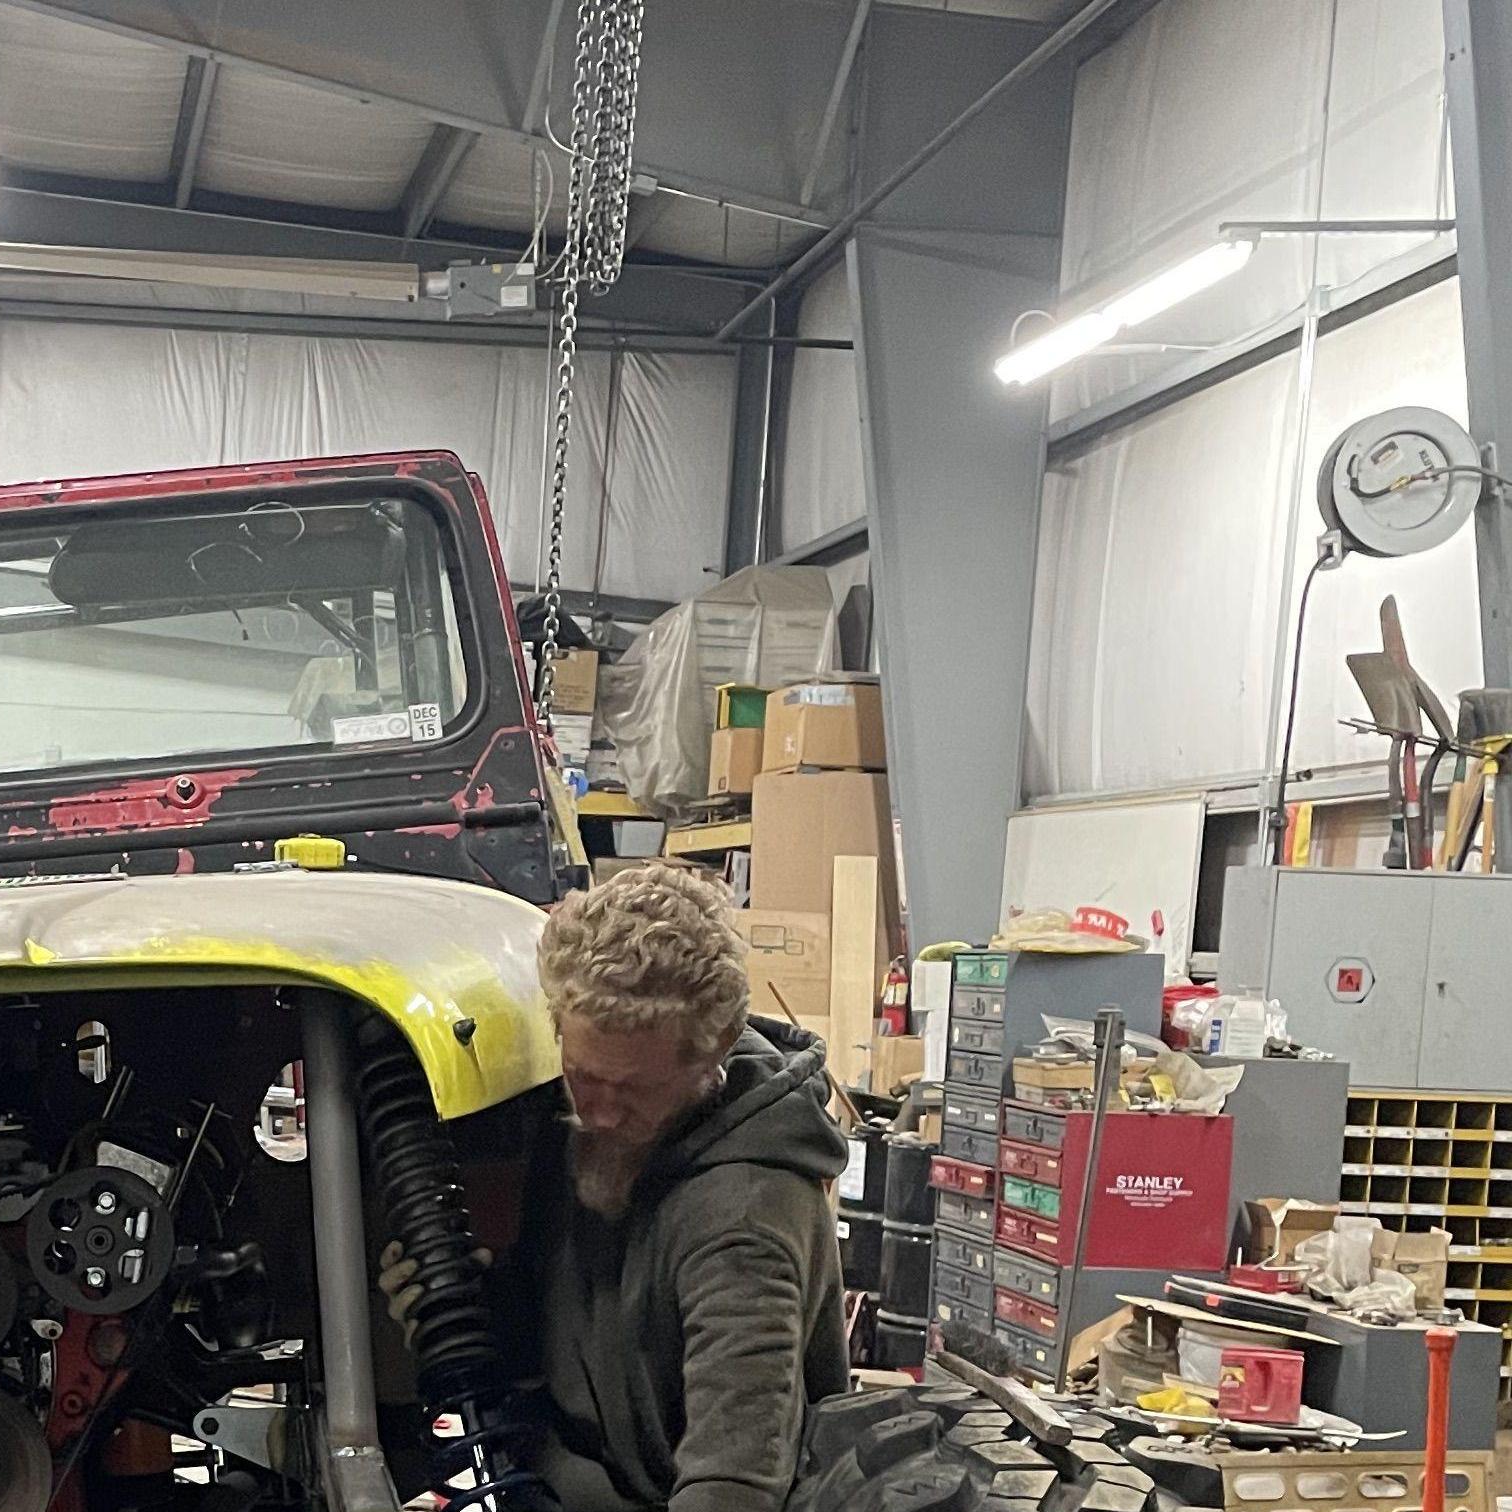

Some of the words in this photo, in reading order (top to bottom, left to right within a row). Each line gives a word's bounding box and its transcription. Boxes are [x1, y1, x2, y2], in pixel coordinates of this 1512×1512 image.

[413, 706, 438, 720] DEC
[419, 723, 435, 737] 15
[1116, 1175, 1184, 1190] STANLEY
